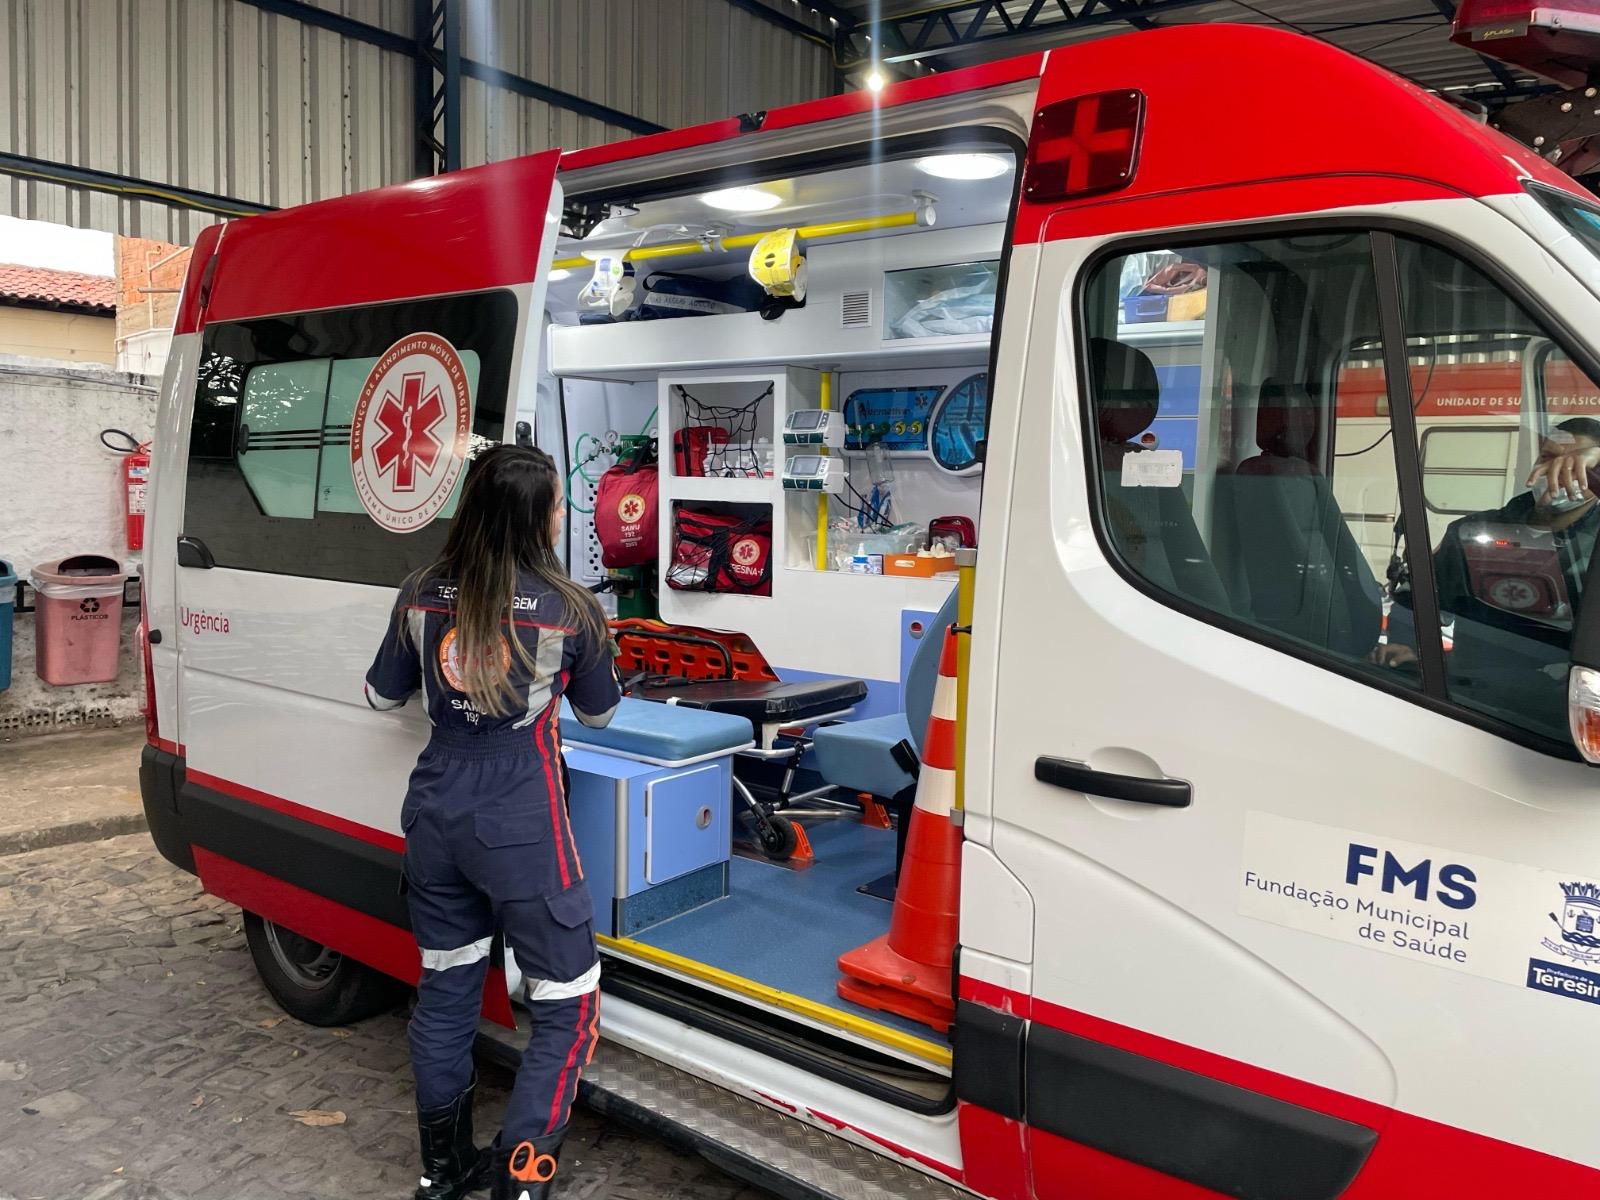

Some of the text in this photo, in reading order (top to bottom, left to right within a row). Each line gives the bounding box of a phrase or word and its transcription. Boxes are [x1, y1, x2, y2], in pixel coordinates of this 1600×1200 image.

[365, 383, 376, 397] DE
[375, 340, 428, 381] ATENDIMENTO
[429, 344, 453, 367] MÓVEL
[451, 364, 461, 380] DE
[1436, 397, 1486, 407] UNIDADE
[1488, 396, 1504, 406] DE
[356, 470, 382, 515] SISTEMA
[385, 512, 414, 525] ÚNICO
[418, 507, 430, 520] DE
[180, 606, 230, 635] Urgência
[1345, 843, 1478, 911] FMS
[1244, 871, 1470, 941] Fundação Municipal
[1358, 922, 1468, 964] de Saúde
[1532, 966, 1600, 998] Teresin
